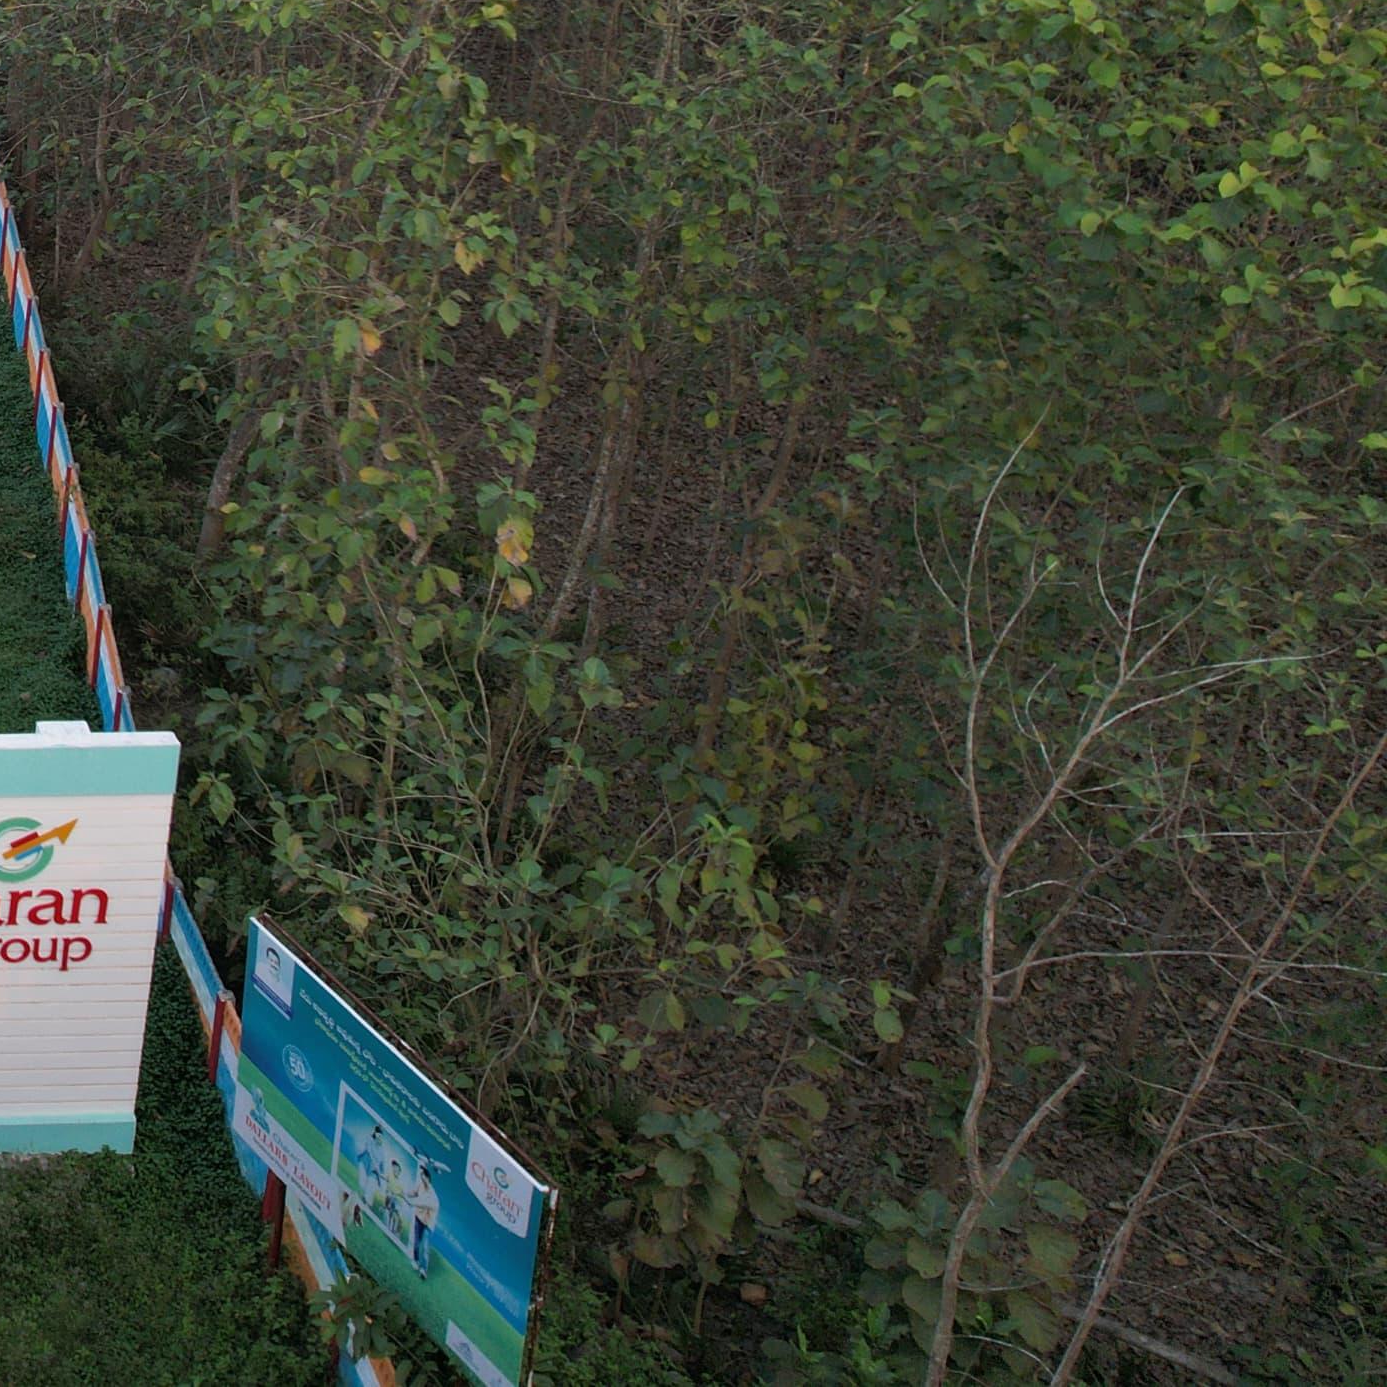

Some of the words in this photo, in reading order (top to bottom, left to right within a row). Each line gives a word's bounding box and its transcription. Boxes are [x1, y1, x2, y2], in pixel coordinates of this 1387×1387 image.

[293, 1166, 331, 1210] LAYOUT
[471, 1161, 521, 1217] Charan
[486, 1192, 517, 1224] group
